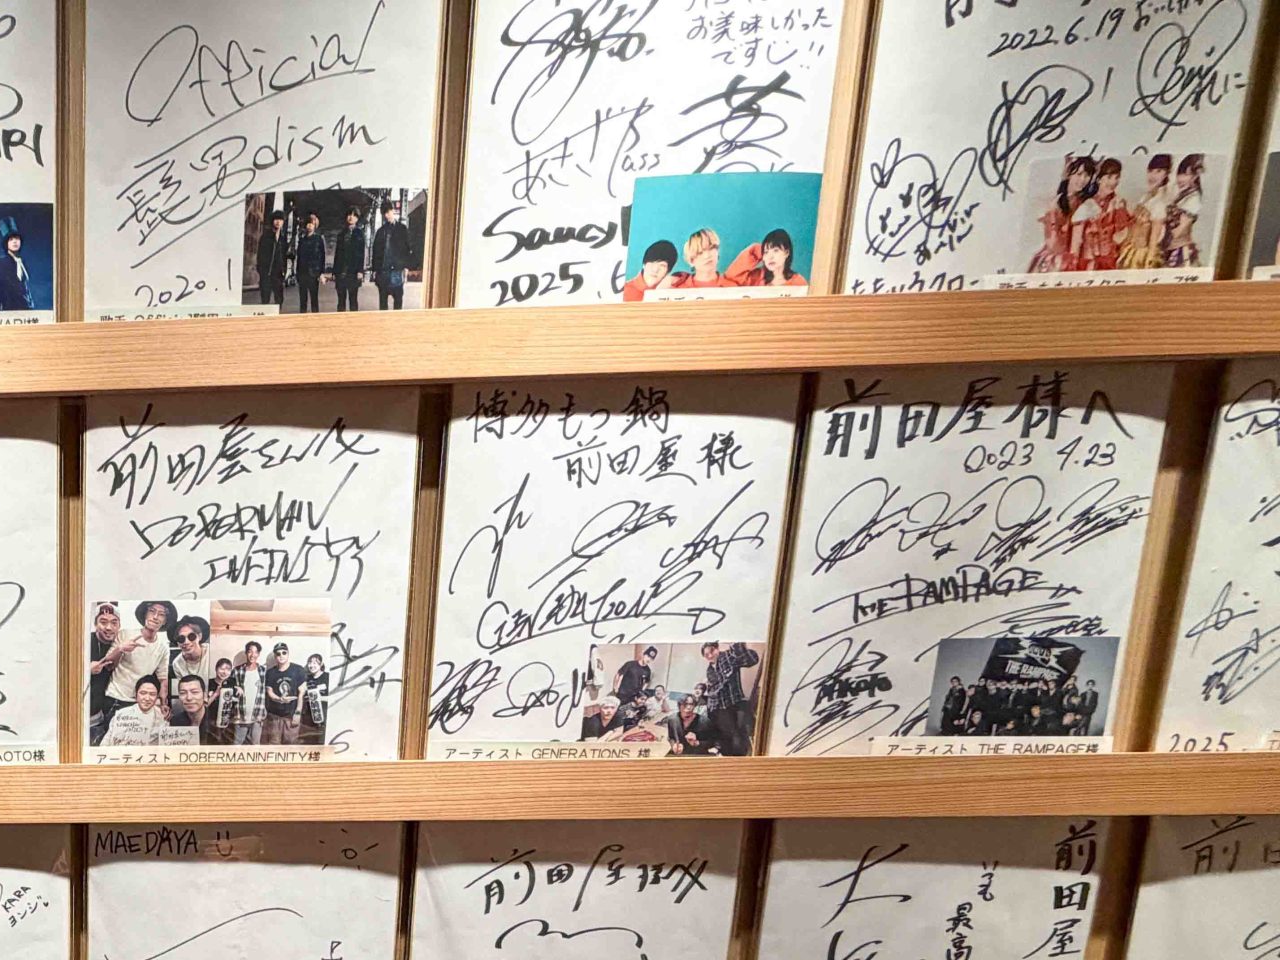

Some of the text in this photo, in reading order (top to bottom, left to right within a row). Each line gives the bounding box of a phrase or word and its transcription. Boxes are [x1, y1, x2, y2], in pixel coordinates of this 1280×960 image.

[445, 748, 523, 760] アーティスト
[531, 747, 631, 759] GENERATIONS
[887, 744, 968, 755] アーティスト
[979, 743, 1006, 754] THE
[96, 751, 321, 764] アーティスト DOBERMANINFINITY様
[94, 829, 199, 858] MAEDAYA
